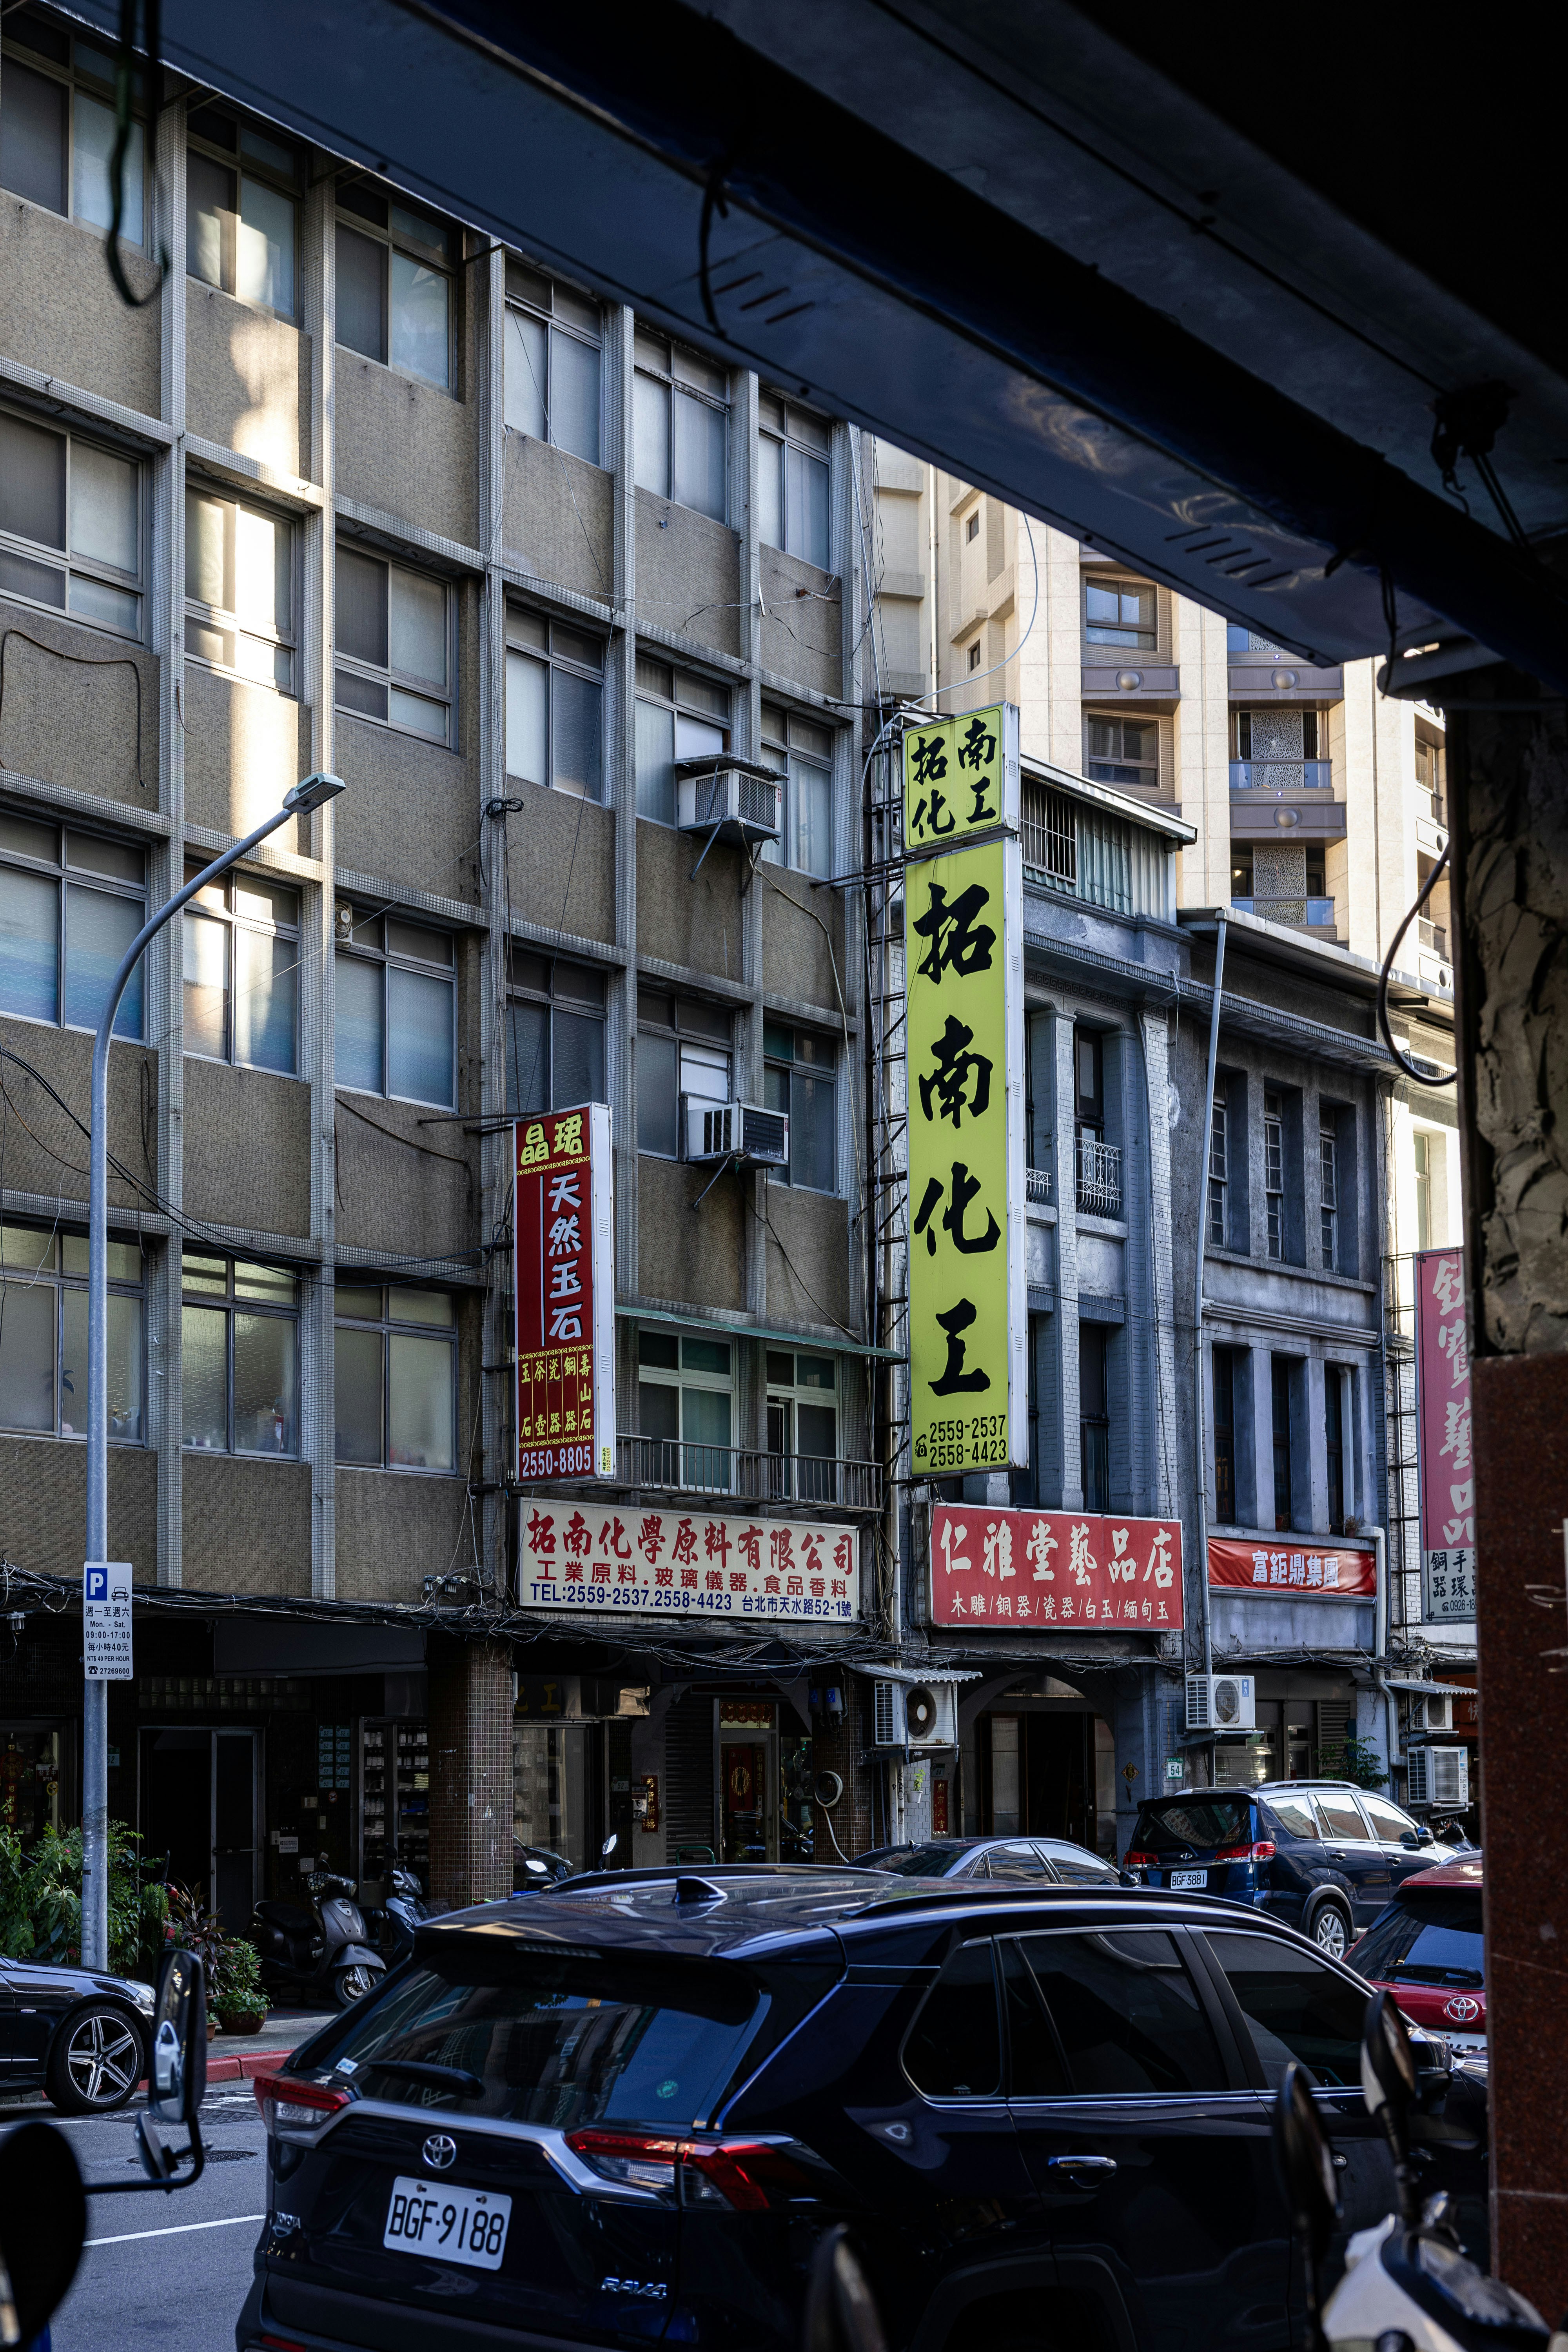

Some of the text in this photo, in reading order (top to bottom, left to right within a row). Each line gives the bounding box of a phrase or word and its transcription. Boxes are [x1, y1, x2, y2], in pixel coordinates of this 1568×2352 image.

[913, 882, 1001, 1396] 拓南化工
[548, 1172, 583, 1340] 天然玉石
[521, 1363, 531, 1437] 玉石
[534, 1360, 546, 1436] 茶壺
[549, 1358, 561, 1434] 瓷器
[564, 1356, 577, 1432] 銅器
[579, 1354, 591, 1430] 壽山石
[929, 1414, 1006, 1443] 2559-2537
[930, 1439, 1006, 1467] 2558-4423
[527, 1508, 853, 1575] 拓南化學原料有限公司
[940, 1518, 1174, 1588] 仁雅堂藝品店
[90, 1573, 103, 1595] P
[1252, 1550, 1339, 1588] 富鉅鼎集團
[1430, 1552, 1447, 1598] 銅器
[85, 1606, 130, 1617] 週一至週六
[88, 1642, 129, 1652] 每小時40元
[1171, 1766, 1179, 1775] 54
[276, 2211, 301, 2229] TOYOTA
[601, 2277, 667, 2299] RAV4
